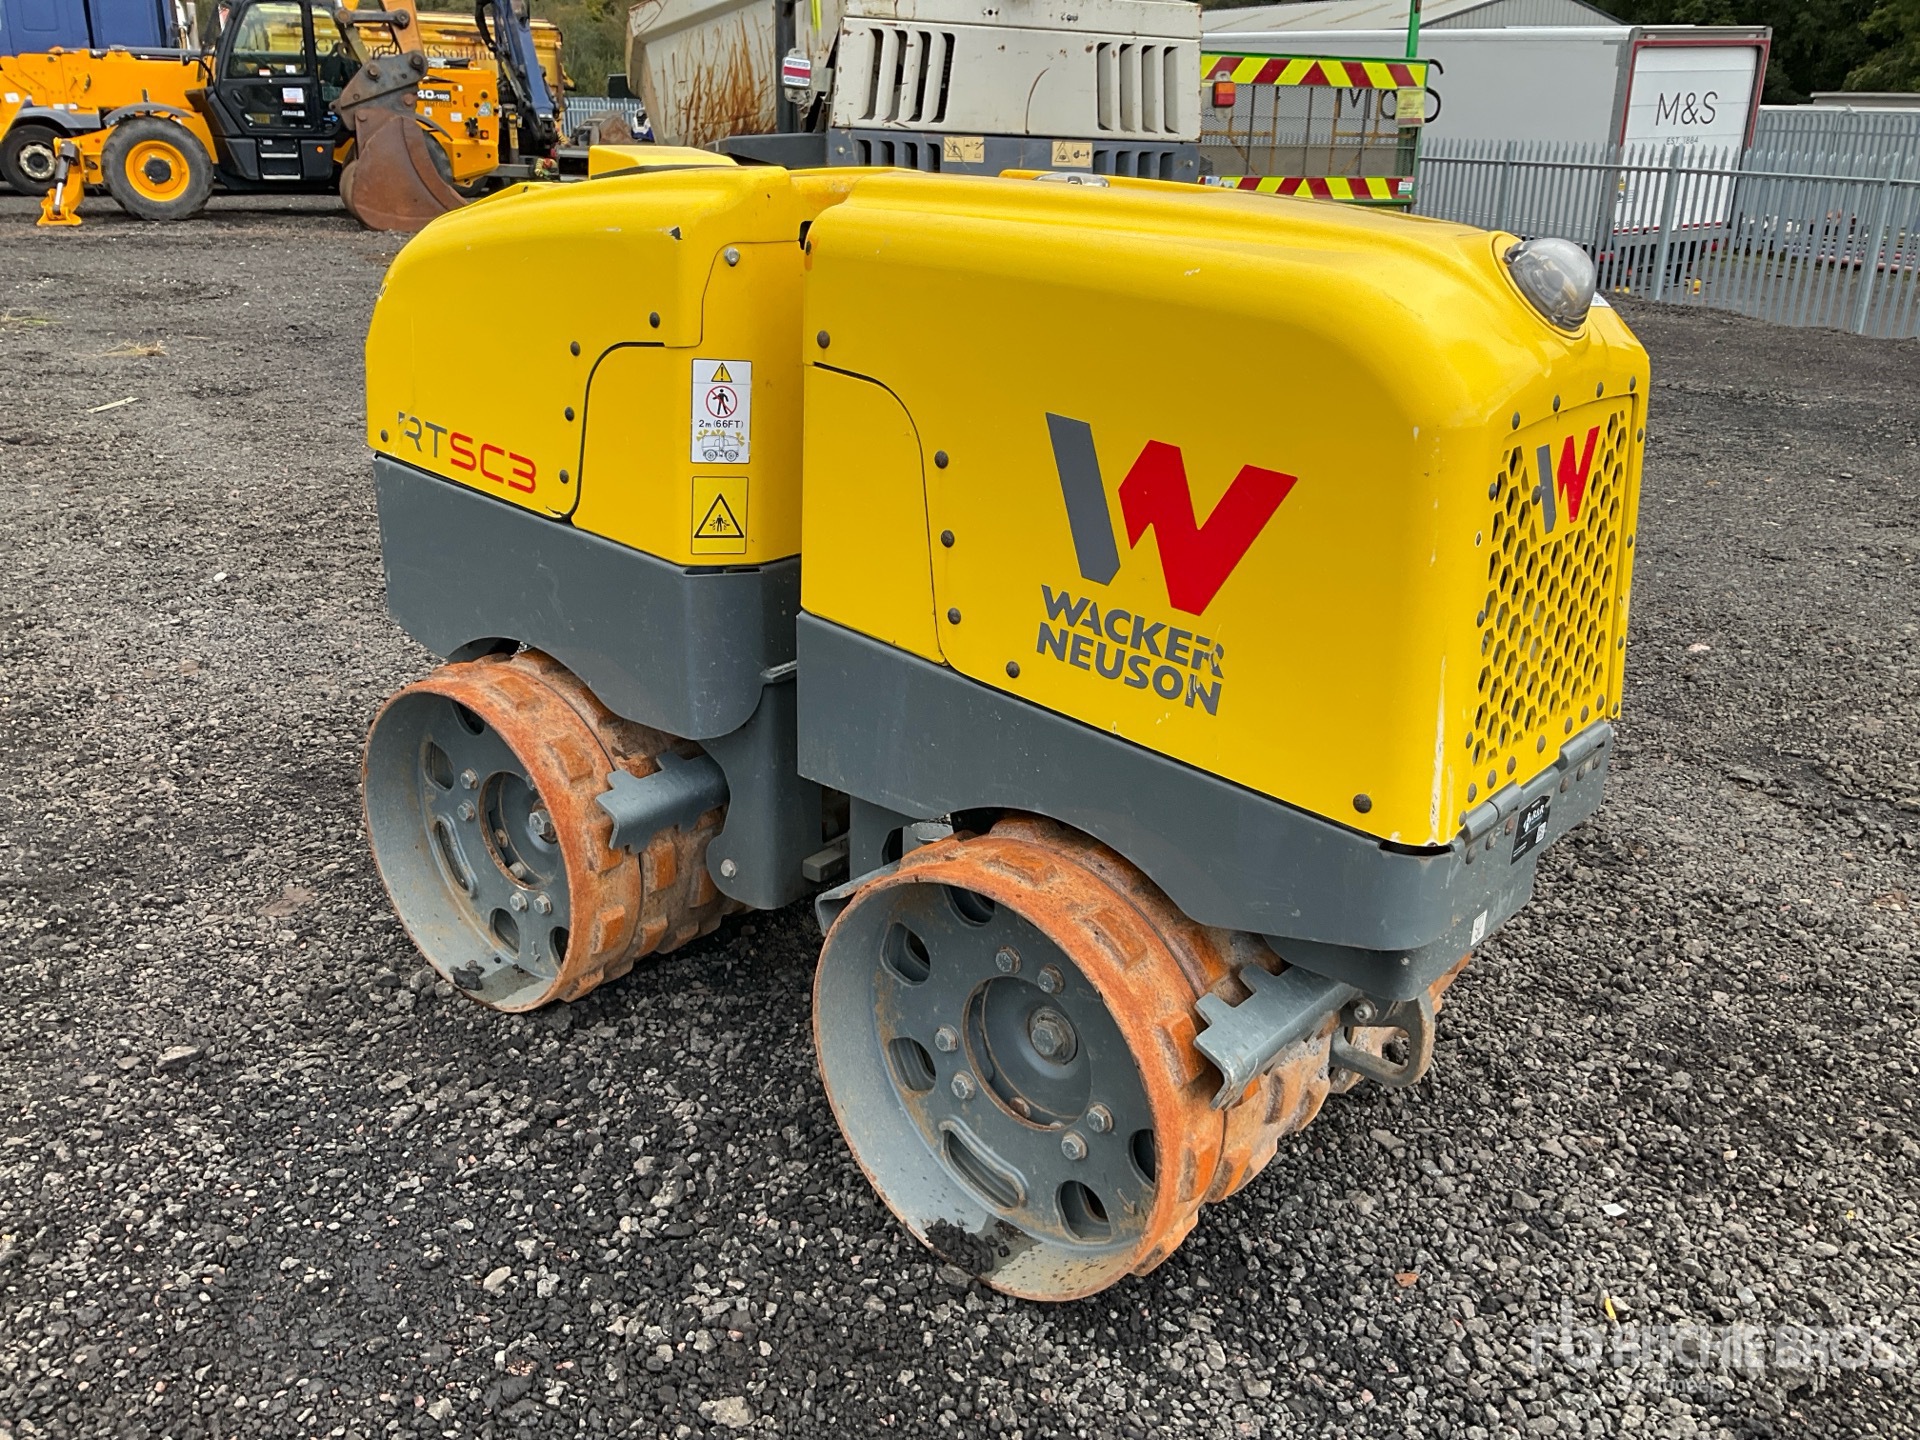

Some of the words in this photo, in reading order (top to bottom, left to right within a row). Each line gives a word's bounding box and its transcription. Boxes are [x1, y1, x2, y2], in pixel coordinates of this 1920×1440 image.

[1655, 91, 1718, 126] M&S
[1683, 136, 1699, 145] 1884
[1041, 584, 1225, 679] WACKER
[1036, 621, 1222, 716] NEUSON
